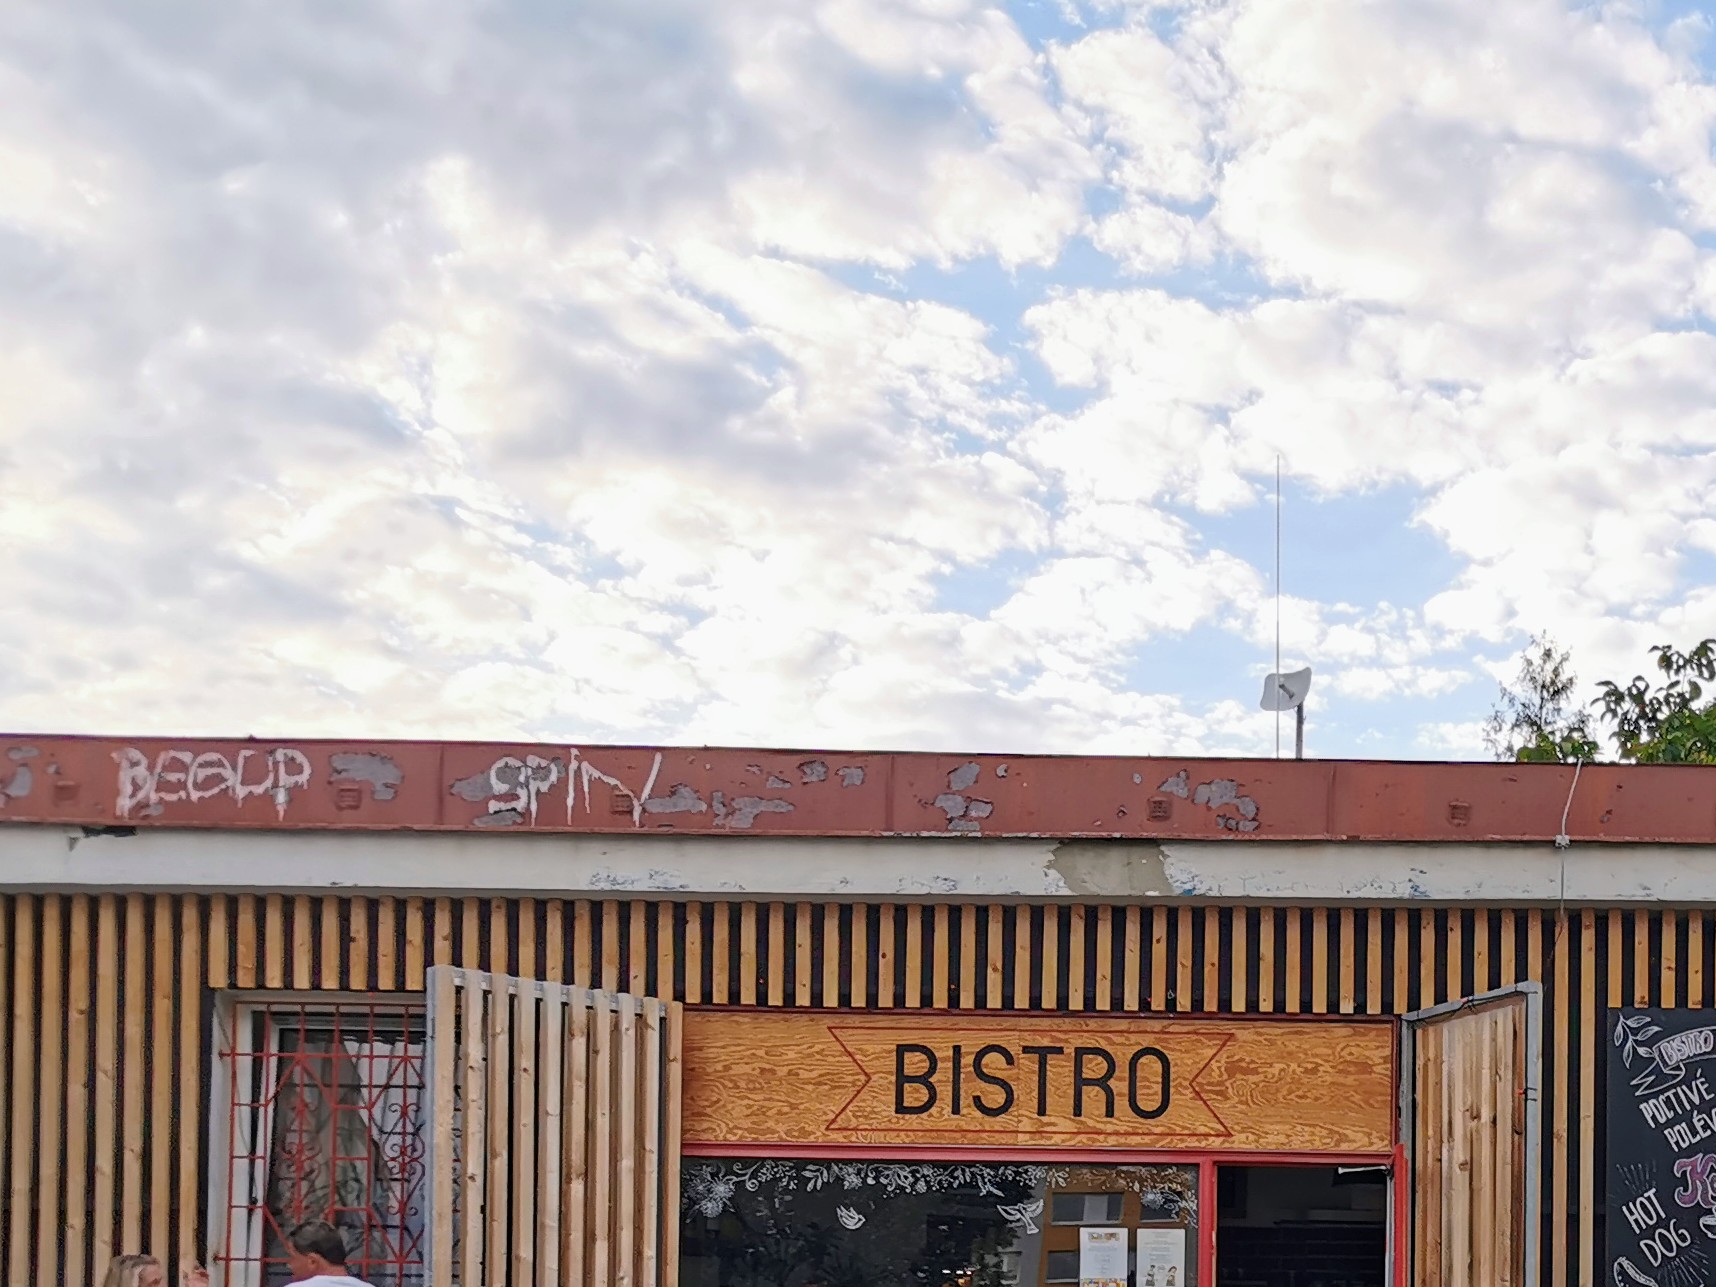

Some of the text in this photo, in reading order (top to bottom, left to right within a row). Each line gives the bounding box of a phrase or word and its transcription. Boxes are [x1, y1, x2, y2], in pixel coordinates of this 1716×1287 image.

[1660, 1030, 1714, 1066] BISTRO
[895, 1044, 1170, 1119] BISTRO
[1639, 1068, 1715, 1128] POCTIVÉ
[1621, 1187, 1667, 1234] HOT
[1640, 1218, 1692, 1267] DOG
